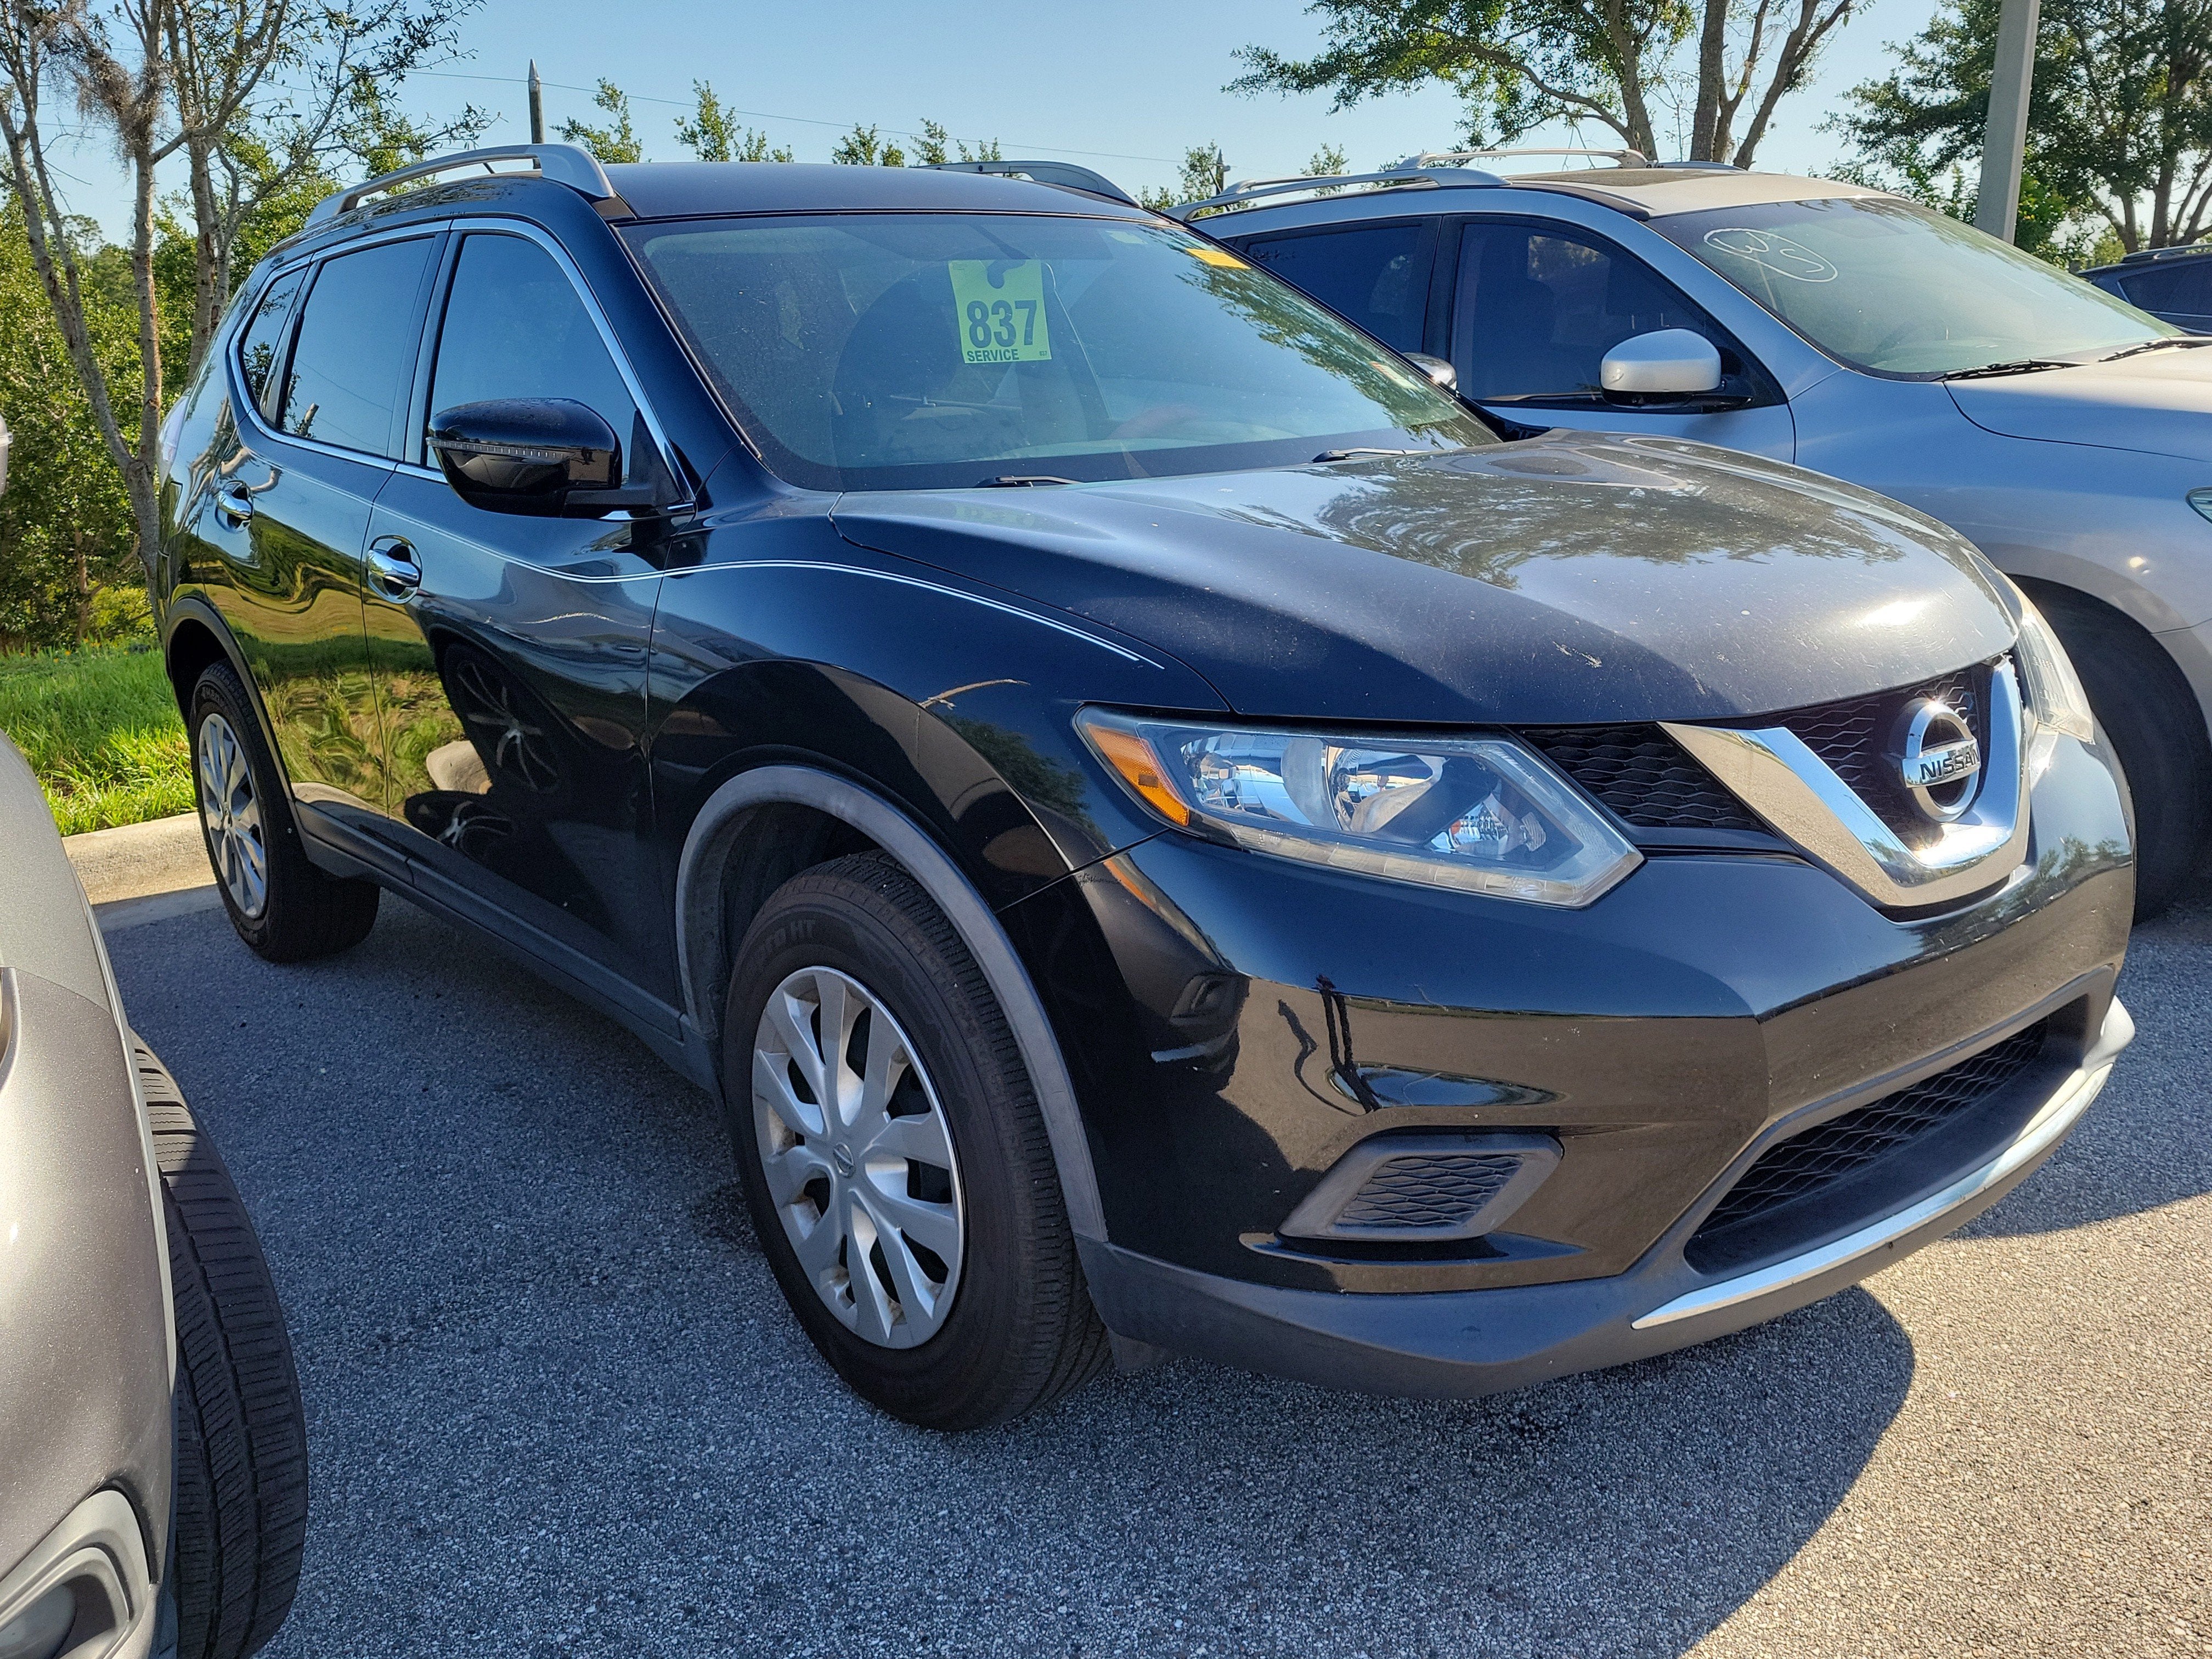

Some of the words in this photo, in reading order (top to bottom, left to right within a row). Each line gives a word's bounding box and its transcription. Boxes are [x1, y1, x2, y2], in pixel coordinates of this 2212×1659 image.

[967, 300, 1037, 348] 837
[967, 348, 1019, 362] SERVICE
[1920, 747, 1980, 780] NISSAN
